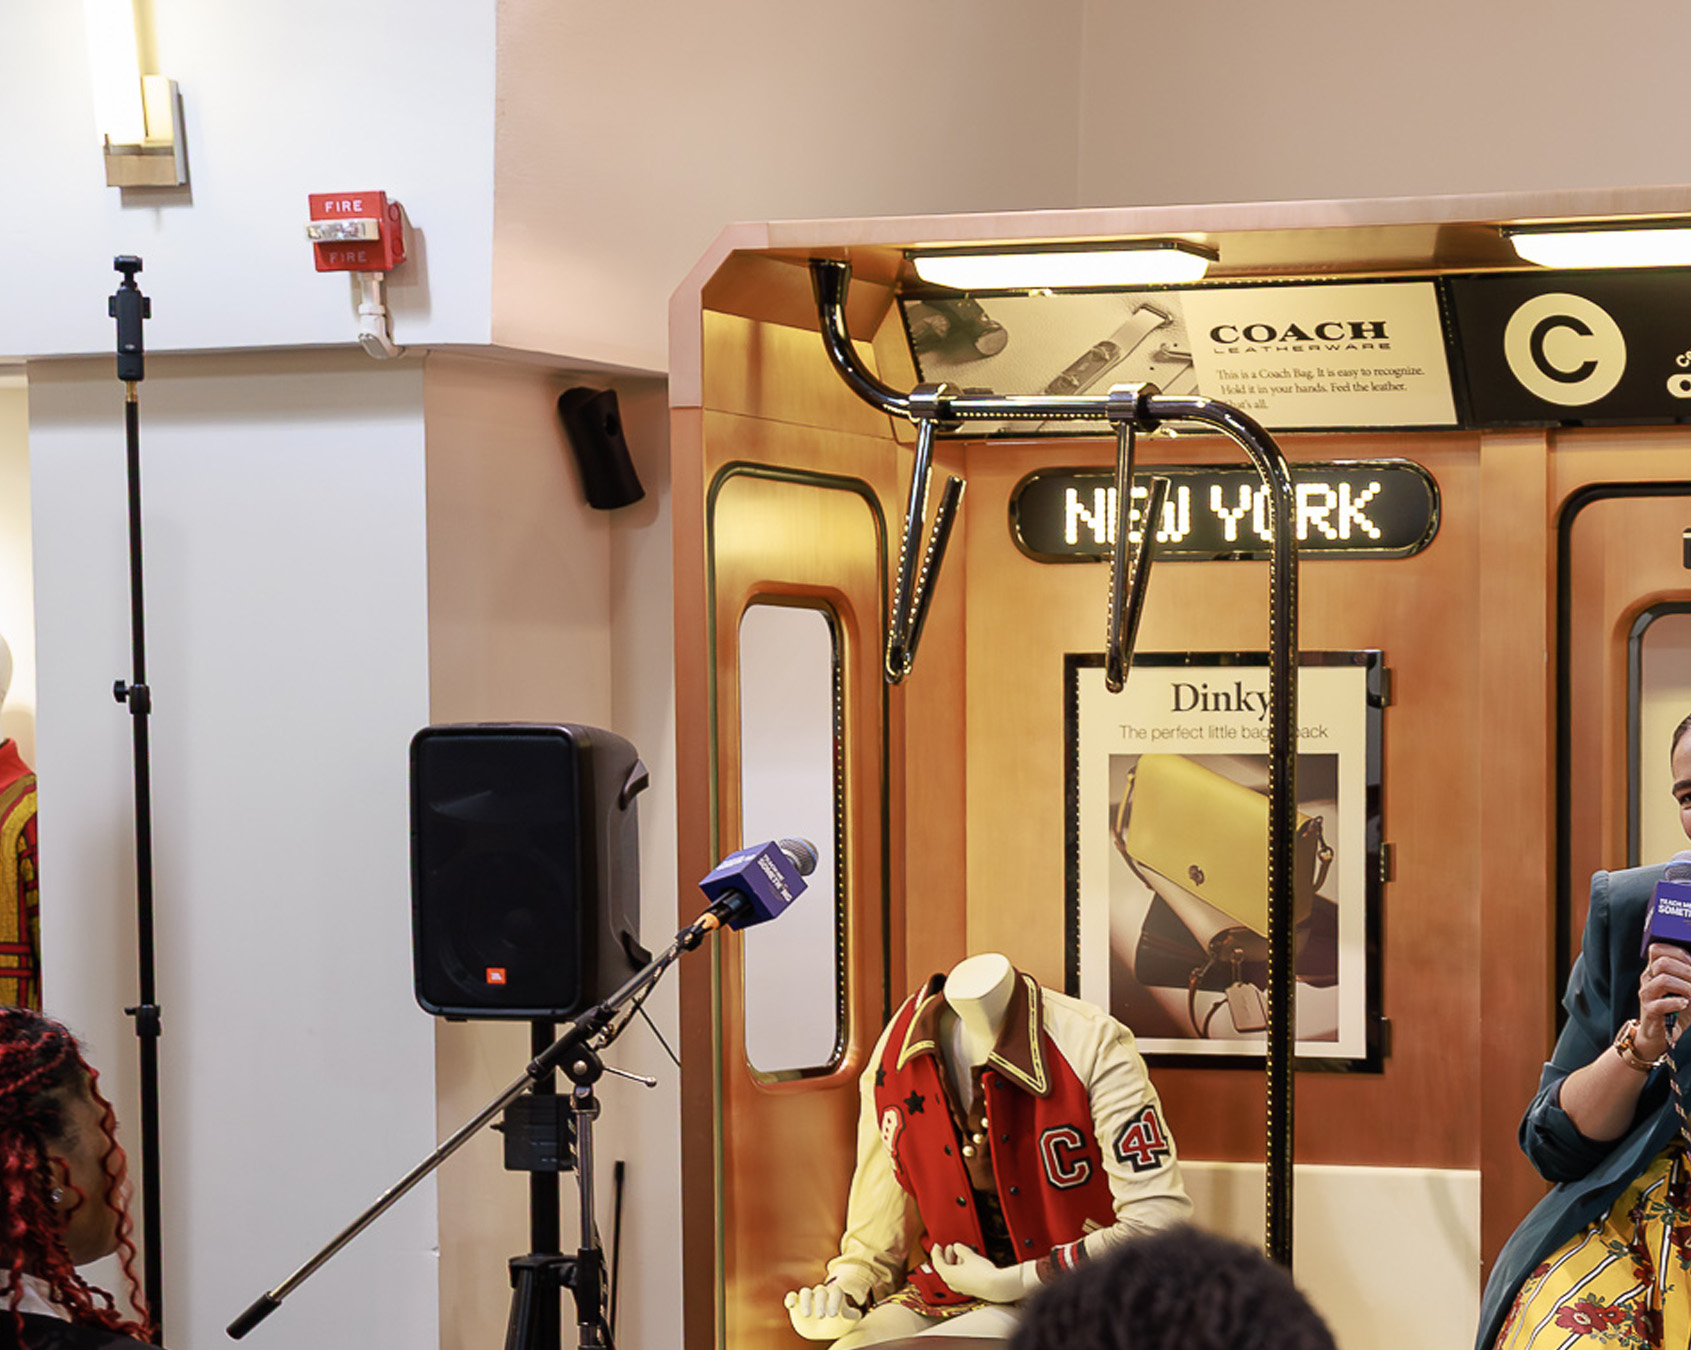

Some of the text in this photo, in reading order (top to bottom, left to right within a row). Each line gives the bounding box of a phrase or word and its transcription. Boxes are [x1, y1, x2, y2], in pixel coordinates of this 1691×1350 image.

[324, 200, 363, 213] FIRE
[329, 251, 368, 263] FIRE
[1210, 320, 1389, 344] COACH
[1213, 342, 1391, 354] LEATHERWARE
[1528, 313, 1599, 384] C
[1216, 369, 1238, 380] This
[1240, 370, 1249, 379] is
[1258, 368, 1291, 379] Coach
[1317, 367, 1325, 377] It
[1326, 368, 1335, 377] is
[1337, 369, 1359, 379] easy
[1360, 368, 1372, 376] to
[1374, 366, 1425, 378] recognize.
[1221, 384, 1246, 394] Hold
[1248, 384, 1256, 393] it
[1257, 385, 1268, 393] in
[1269, 385, 1293, 396] your
[1330, 382, 1351, 392] Feel
[1352, 381, 1369, 392] the
[1370, 380, 1407, 392] leather.
[1065, 485, 1191, 546] NEW
[1171, 680, 1271, 721] Dinky
[1119, 724, 1148, 739] The
[1151, 724, 1204, 741] perfect
[1208, 724, 1237, 740] little
[1296, 724, 1328, 739] ack
[1039, 1123, 1093, 1190] C
